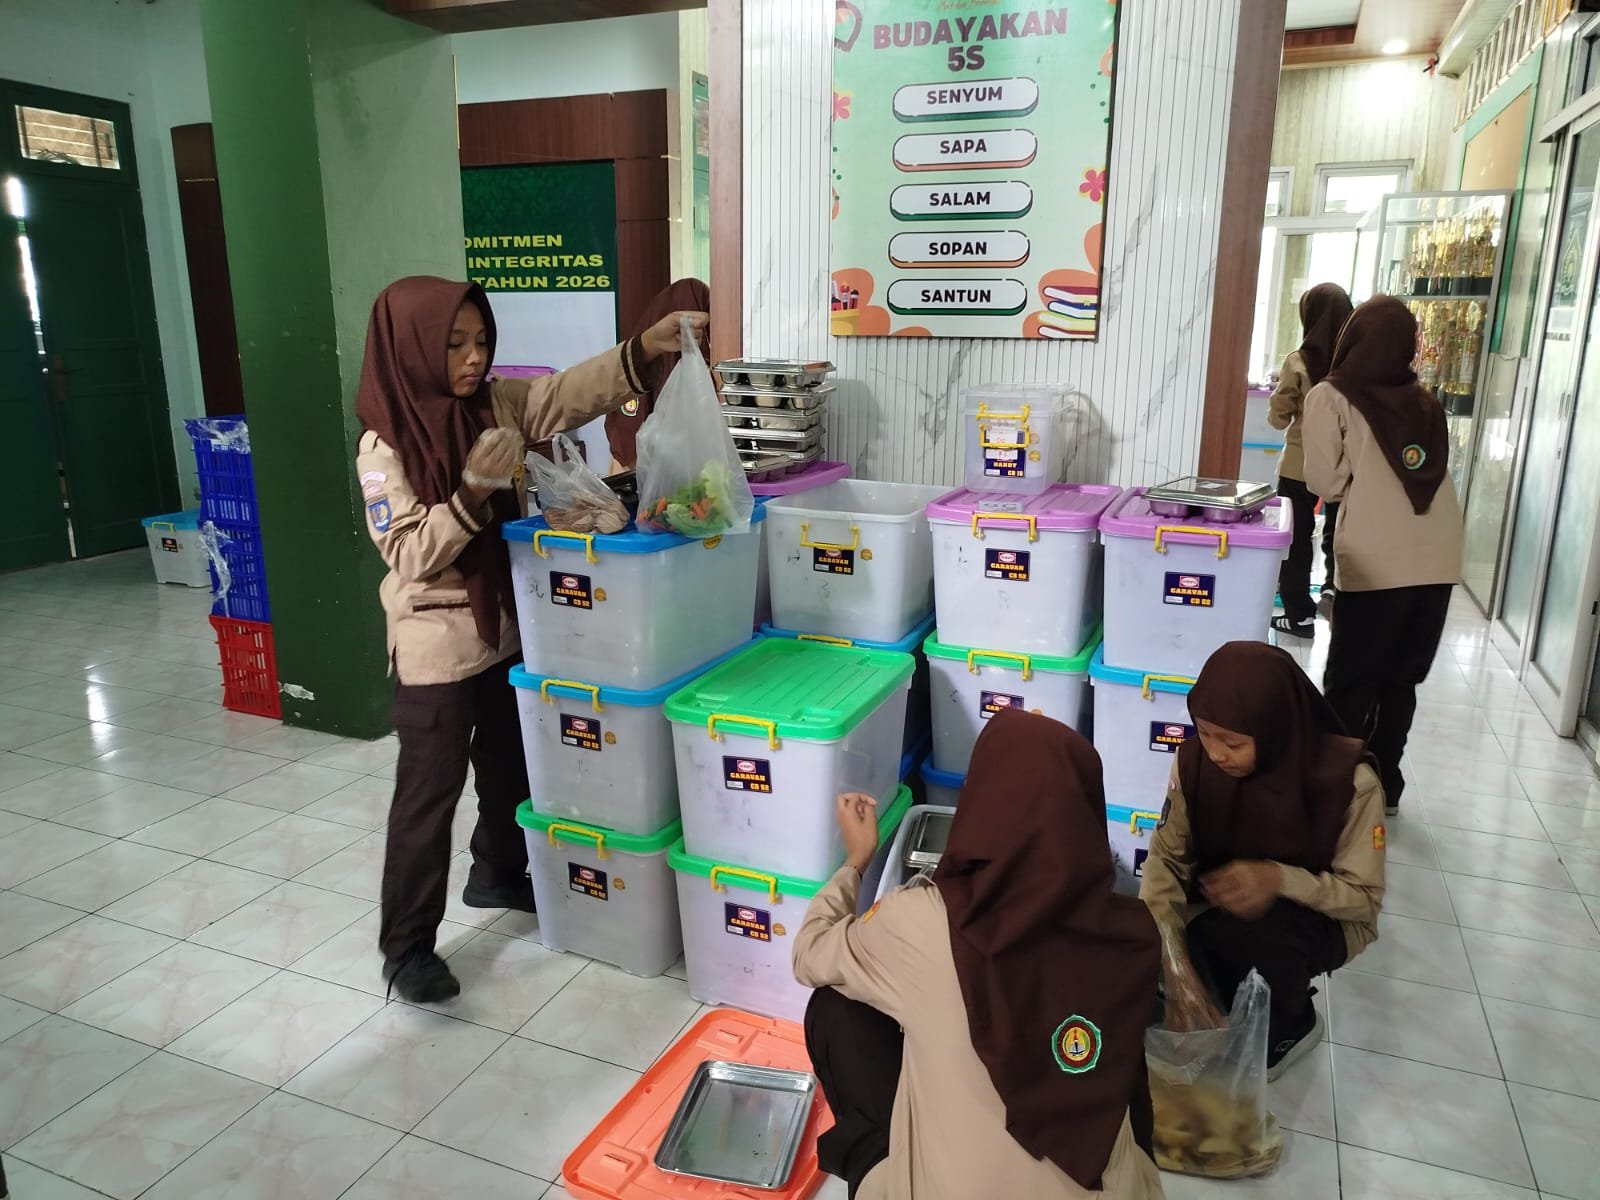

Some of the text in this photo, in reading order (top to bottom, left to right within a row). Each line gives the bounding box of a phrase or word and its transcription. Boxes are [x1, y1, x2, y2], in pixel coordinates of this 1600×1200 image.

[873, 8, 1068, 50] BUDAYAKAN
[947, 45, 986, 72] 5S
[926, 86, 1003, 105] SENYUM
[940, 139, 987, 154] SAPA
[929, 191, 991, 206] SALAM
[464, 234, 563, 249] OMITMEN
[928, 241, 987, 256] SOPAN
[468, 254, 604, 269] INTEGRITAS
[472, 275, 611, 289] TAHUN 2026
[921, 289, 992, 303] SANTUN
[990, 562, 1025, 571] CARAVAN
[1170, 587, 1209, 596] CARAVAN
[1156, 735, 1185, 743] CARAV
[730, 772, 766, 781] CARAVAN
[731, 918, 766, 931] CARAVAN
